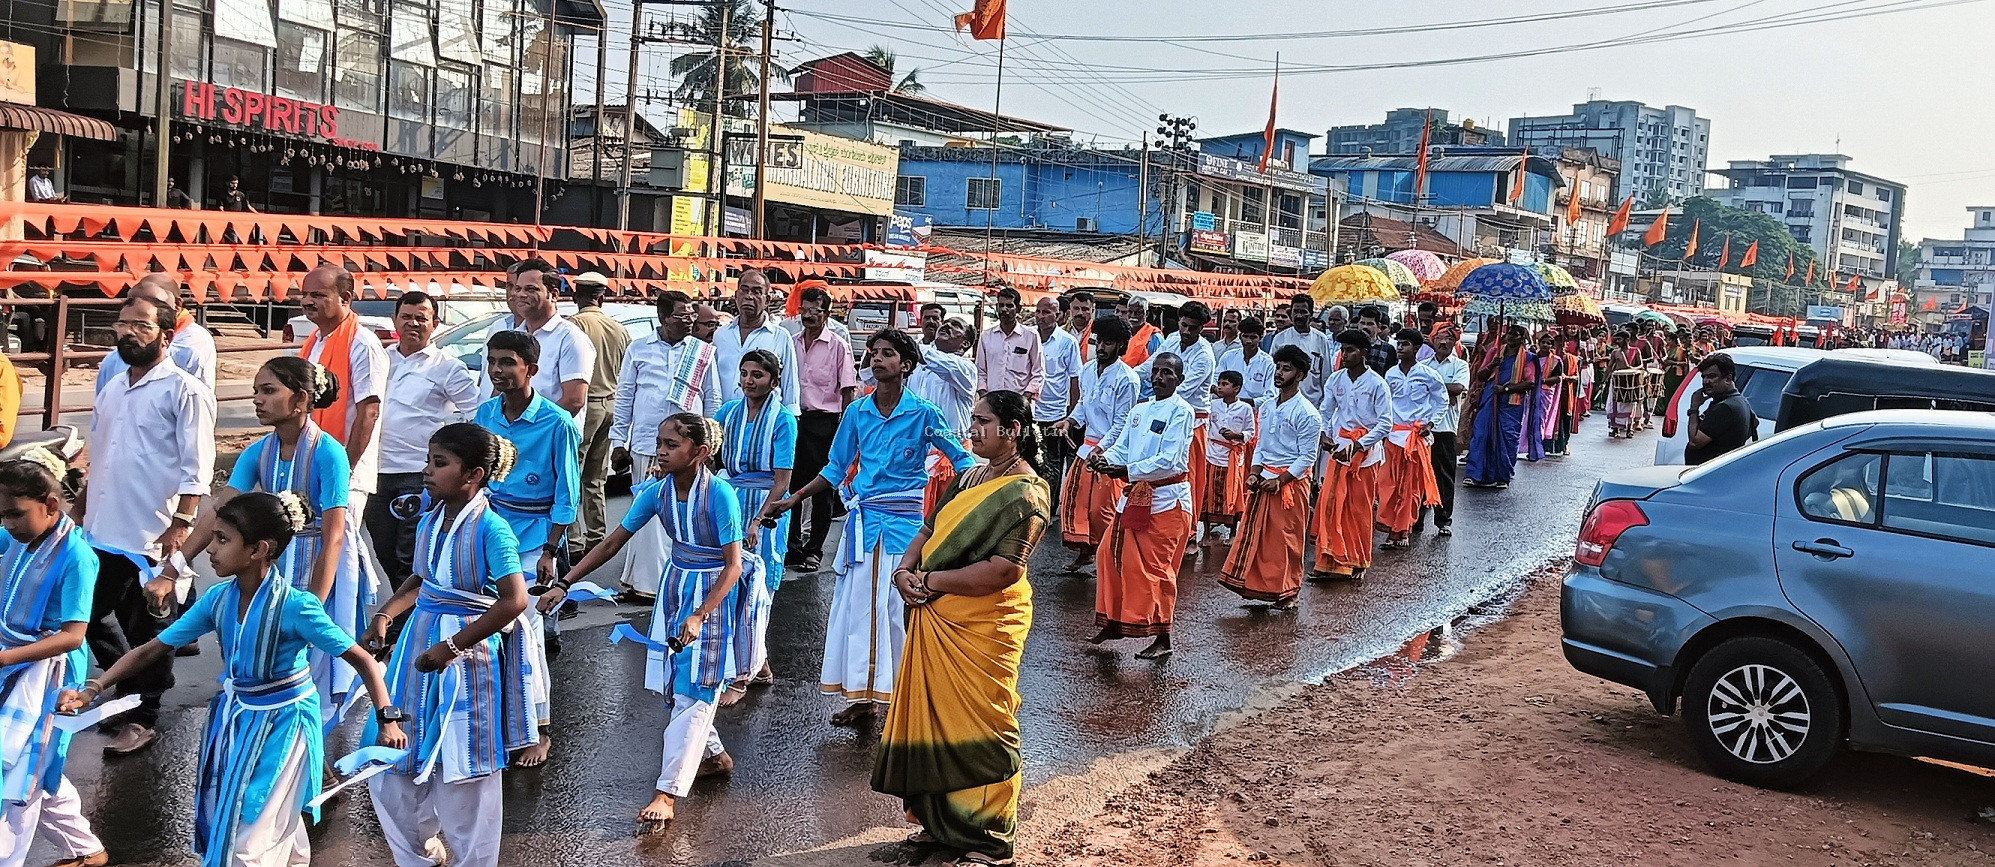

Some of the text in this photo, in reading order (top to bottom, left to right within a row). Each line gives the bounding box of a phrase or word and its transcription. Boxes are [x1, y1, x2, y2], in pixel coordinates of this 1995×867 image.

[184, 80, 339, 139] HI SPIRITS
[729, 140, 800, 167] WIES
[839, 164, 896, 201] FURNITURE
